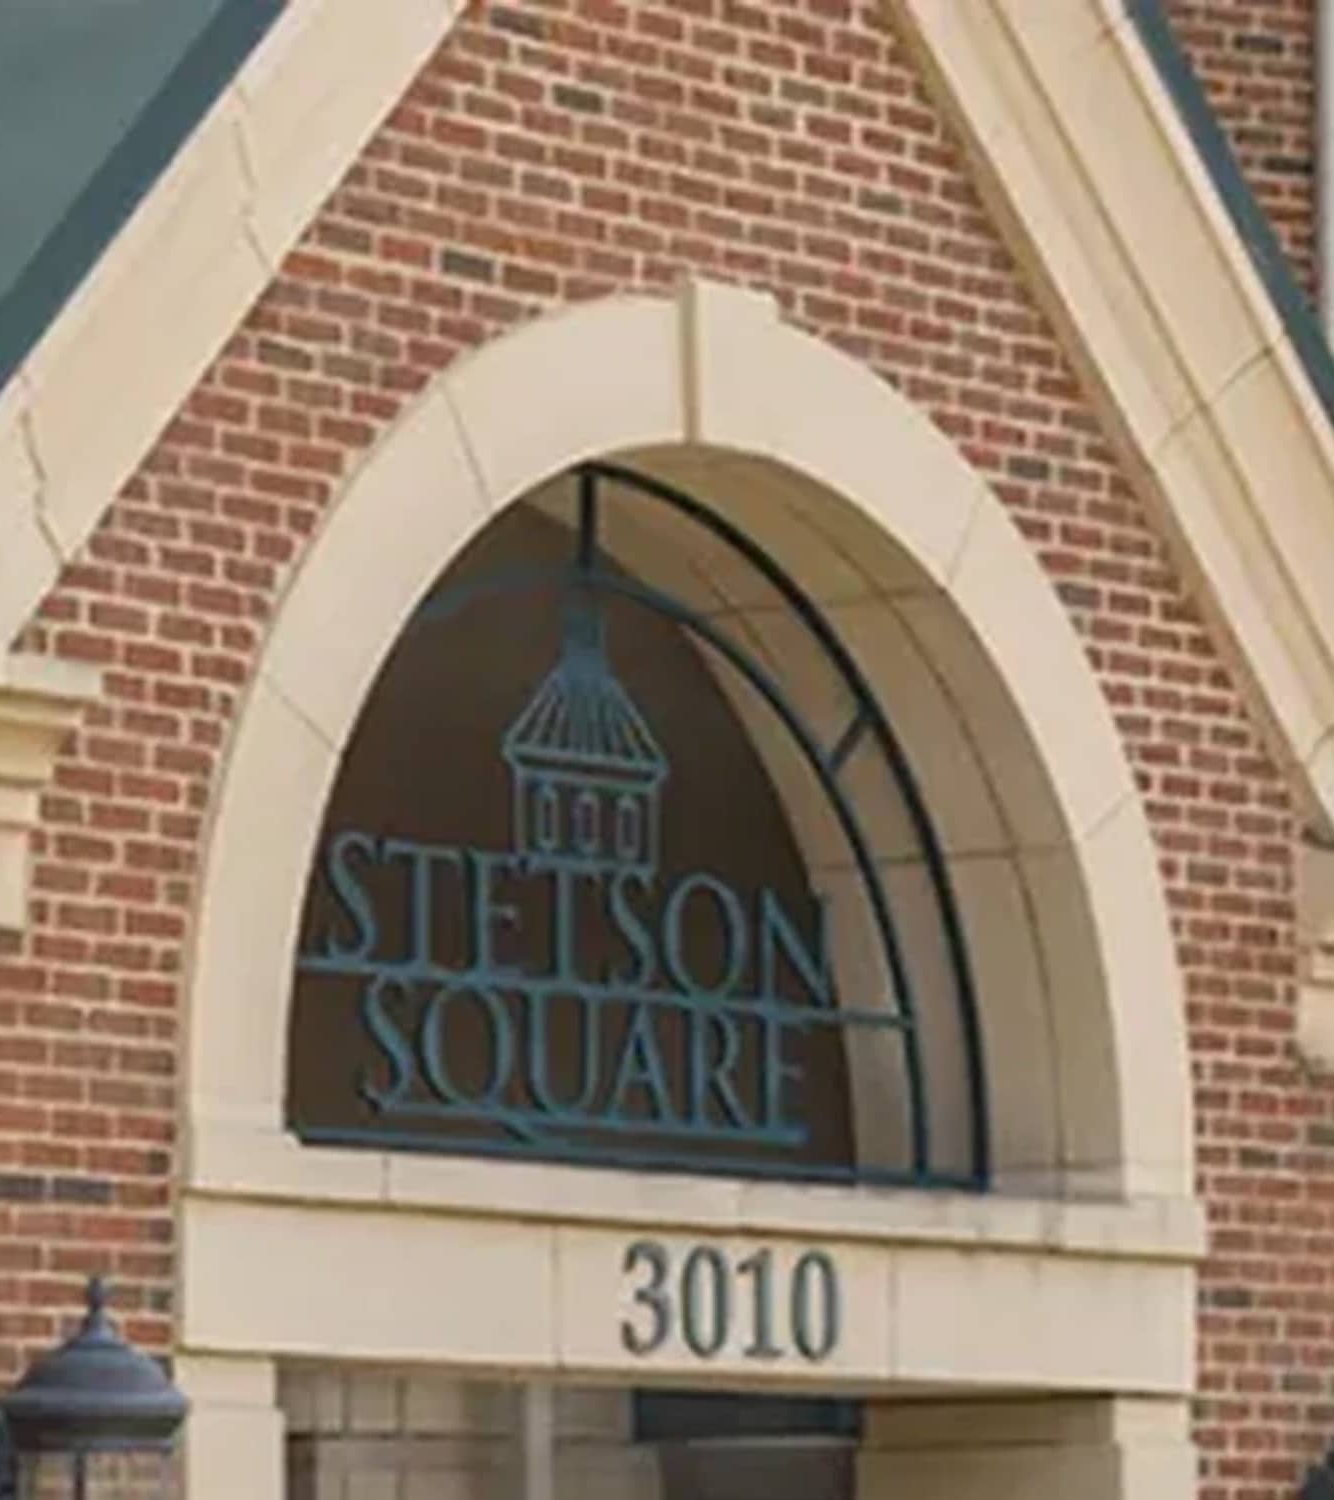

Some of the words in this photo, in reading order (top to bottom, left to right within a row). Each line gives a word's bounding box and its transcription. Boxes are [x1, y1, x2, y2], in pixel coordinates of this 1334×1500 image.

[325, 831, 834, 1004] STETSON
[363, 975, 806, 1143] SQUARE
[620, 1242, 840, 1359] 3010
